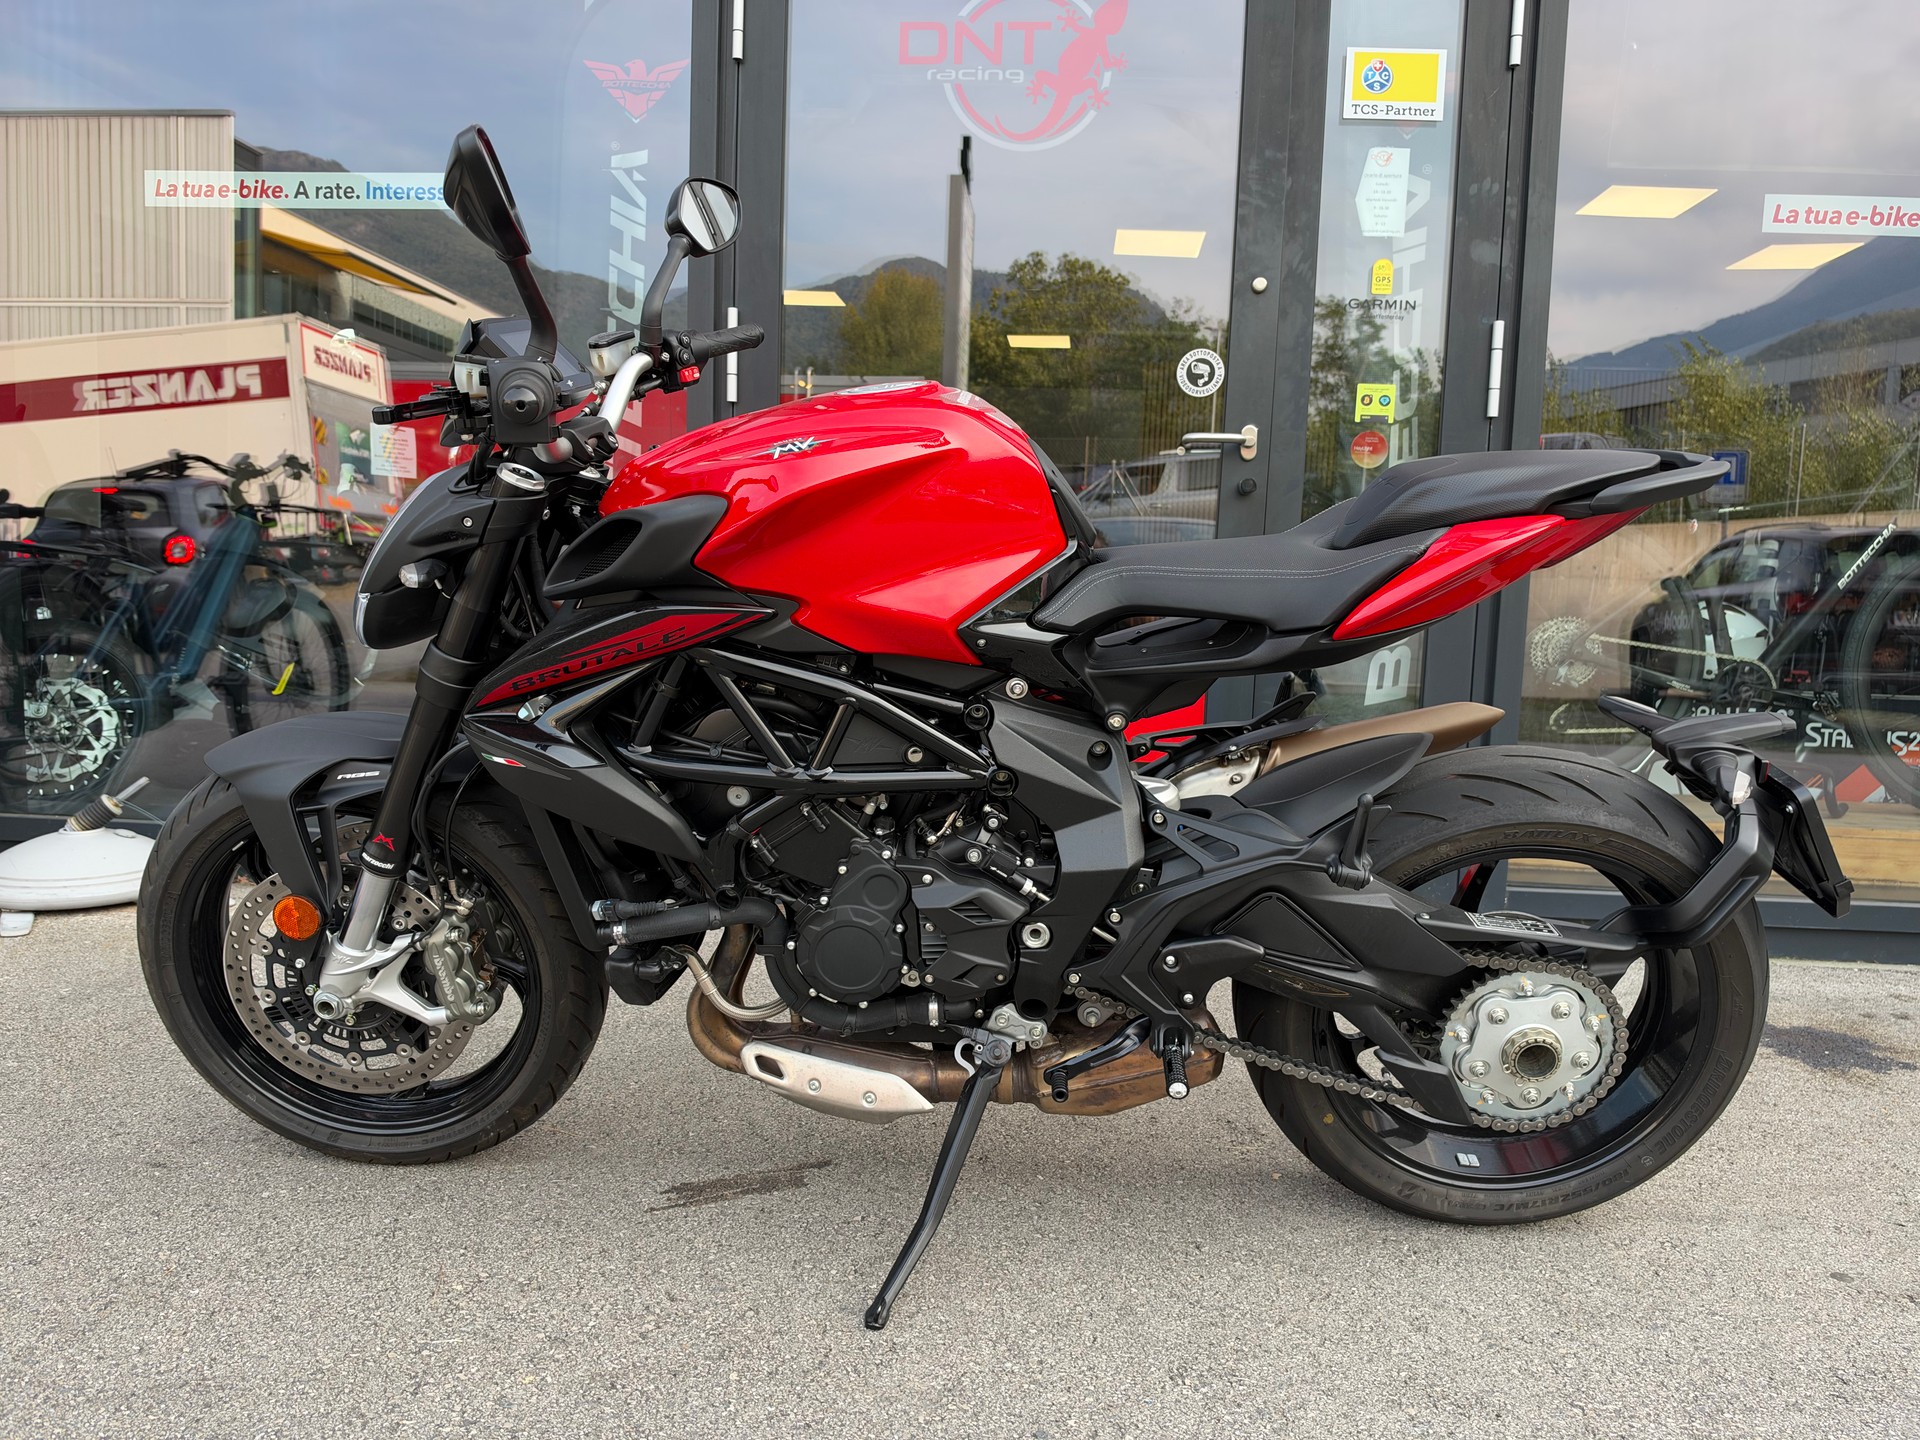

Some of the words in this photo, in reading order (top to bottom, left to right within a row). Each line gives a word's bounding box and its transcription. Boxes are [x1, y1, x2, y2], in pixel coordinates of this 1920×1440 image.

[899, 20, 1053, 65] DNT
[926, 65, 1025, 84] racing
[1351, 103, 1437, 117] TCS-Partner
[154, 178, 178, 198] La
[182, 180, 215, 199] tua
[293, 180, 310, 200] A
[315, 181, 361, 201] rate.
[1771, 203, 1800, 224] La
[1804, 206, 1843, 225] tua
[1375, 276, 1392, 284] GPS
[1348, 298, 1417, 311] GARMIN
[1837, 523, 1897, 590] BOTTECCHIA
[509, 626, 686, 692] BRUTALE
